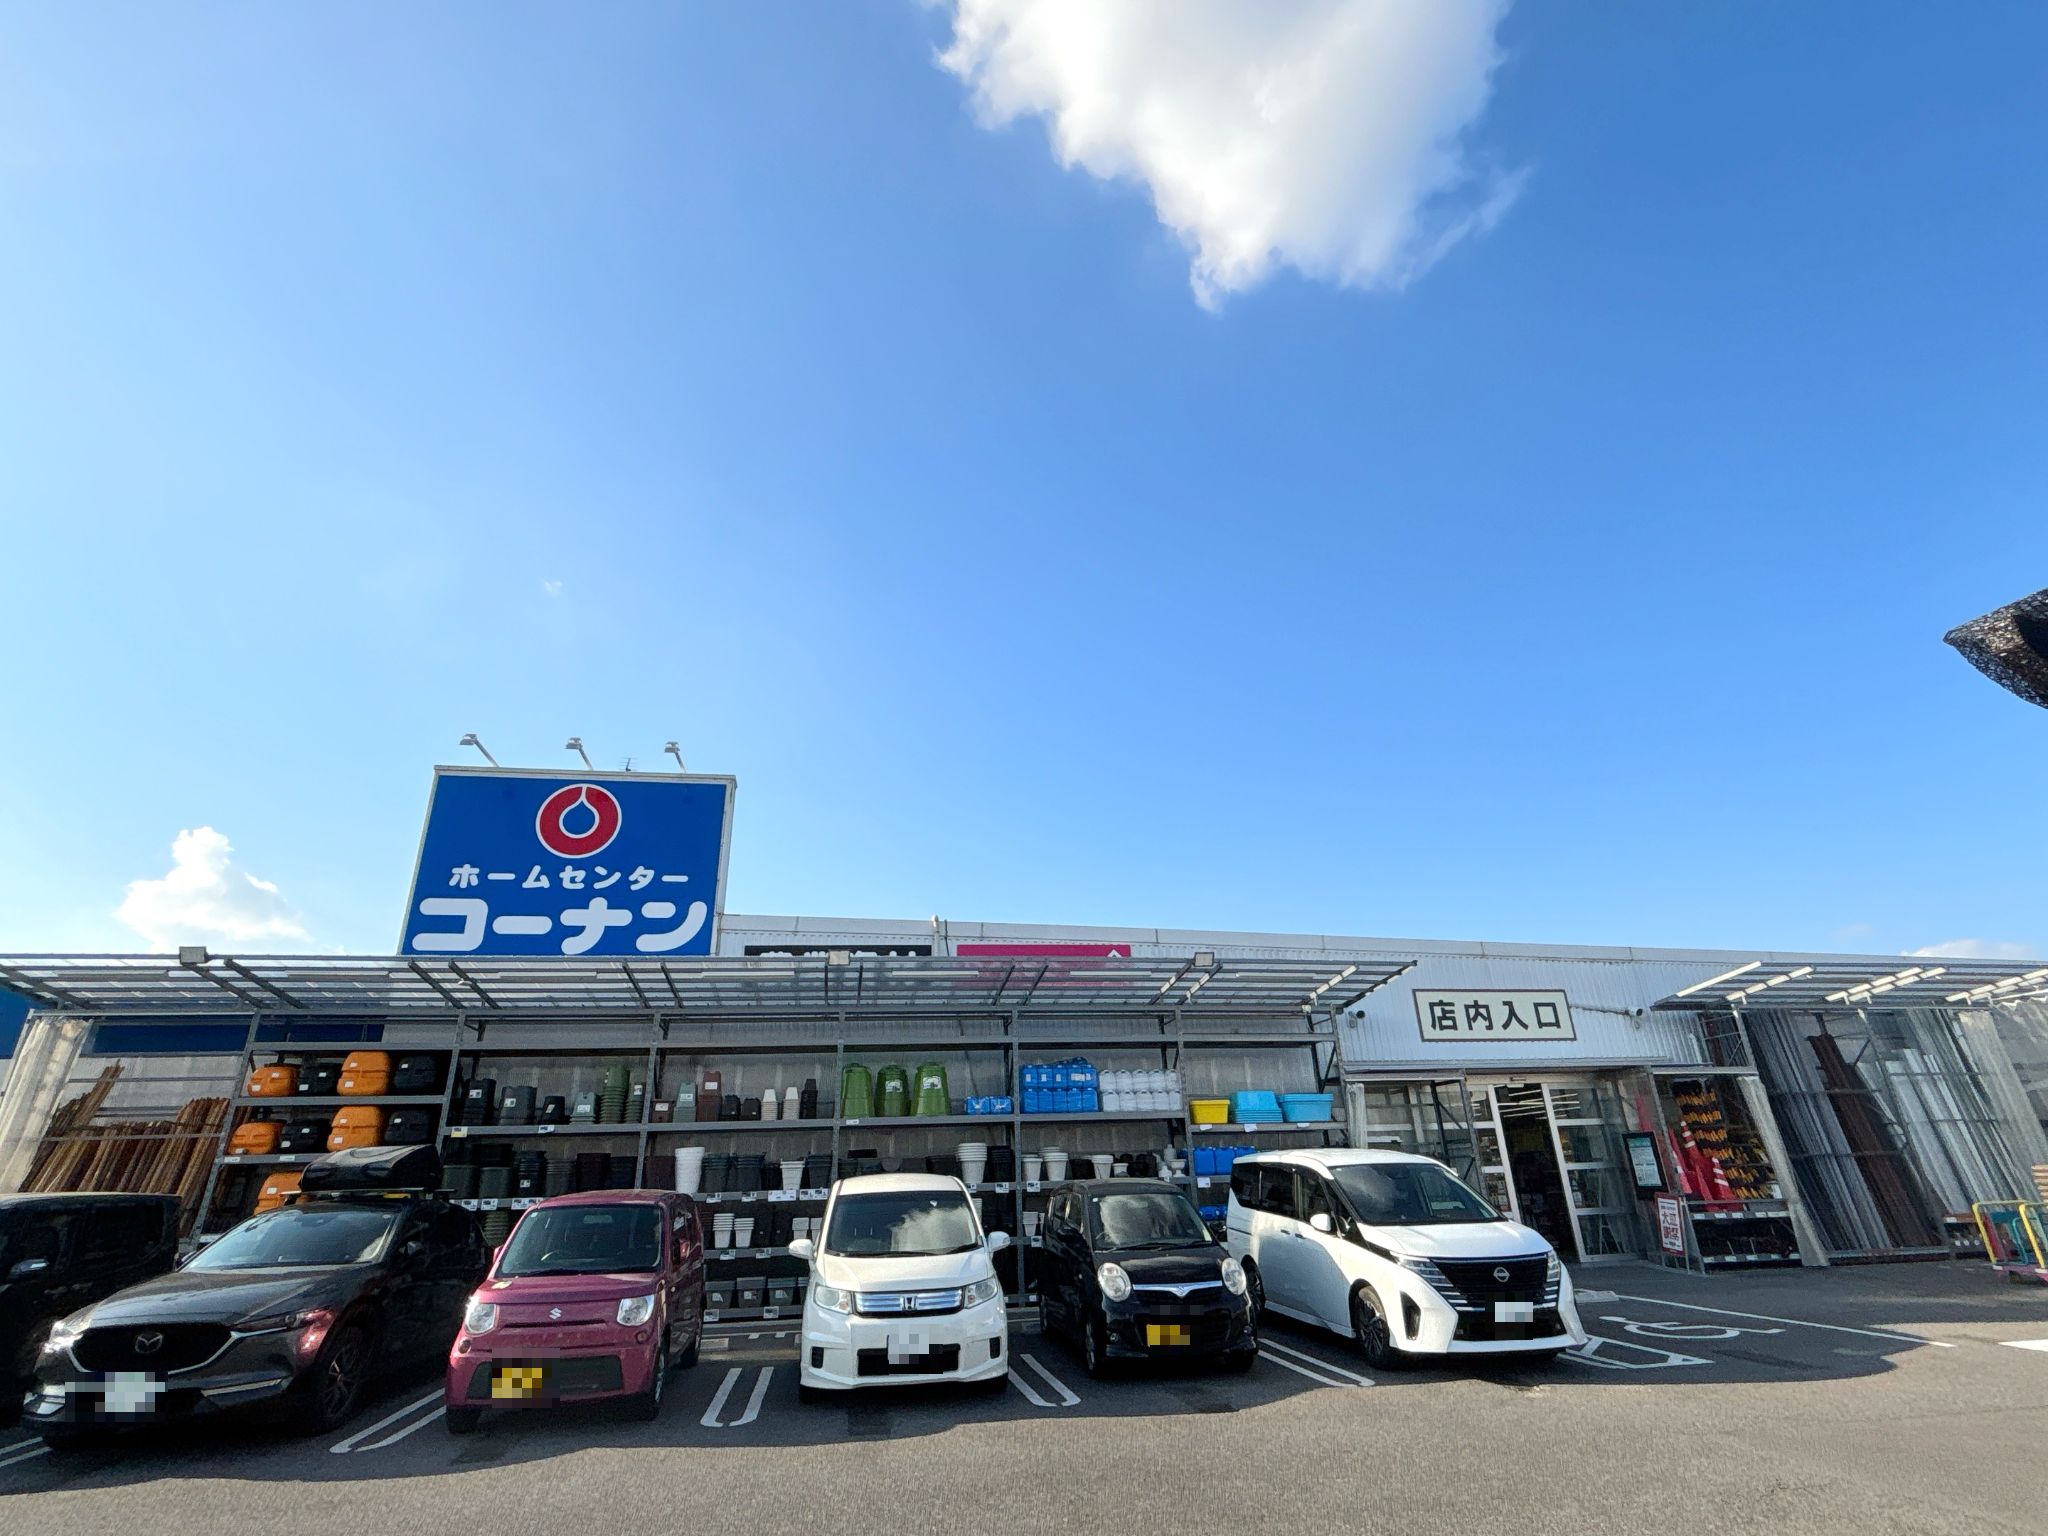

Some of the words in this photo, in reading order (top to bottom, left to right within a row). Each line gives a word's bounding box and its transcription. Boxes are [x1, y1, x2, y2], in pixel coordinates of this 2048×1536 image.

[449, 864, 689, 891] ホームセンター
[412, 897, 708, 955] コーナン
[1428, 999, 1562, 1031] 店内入口
